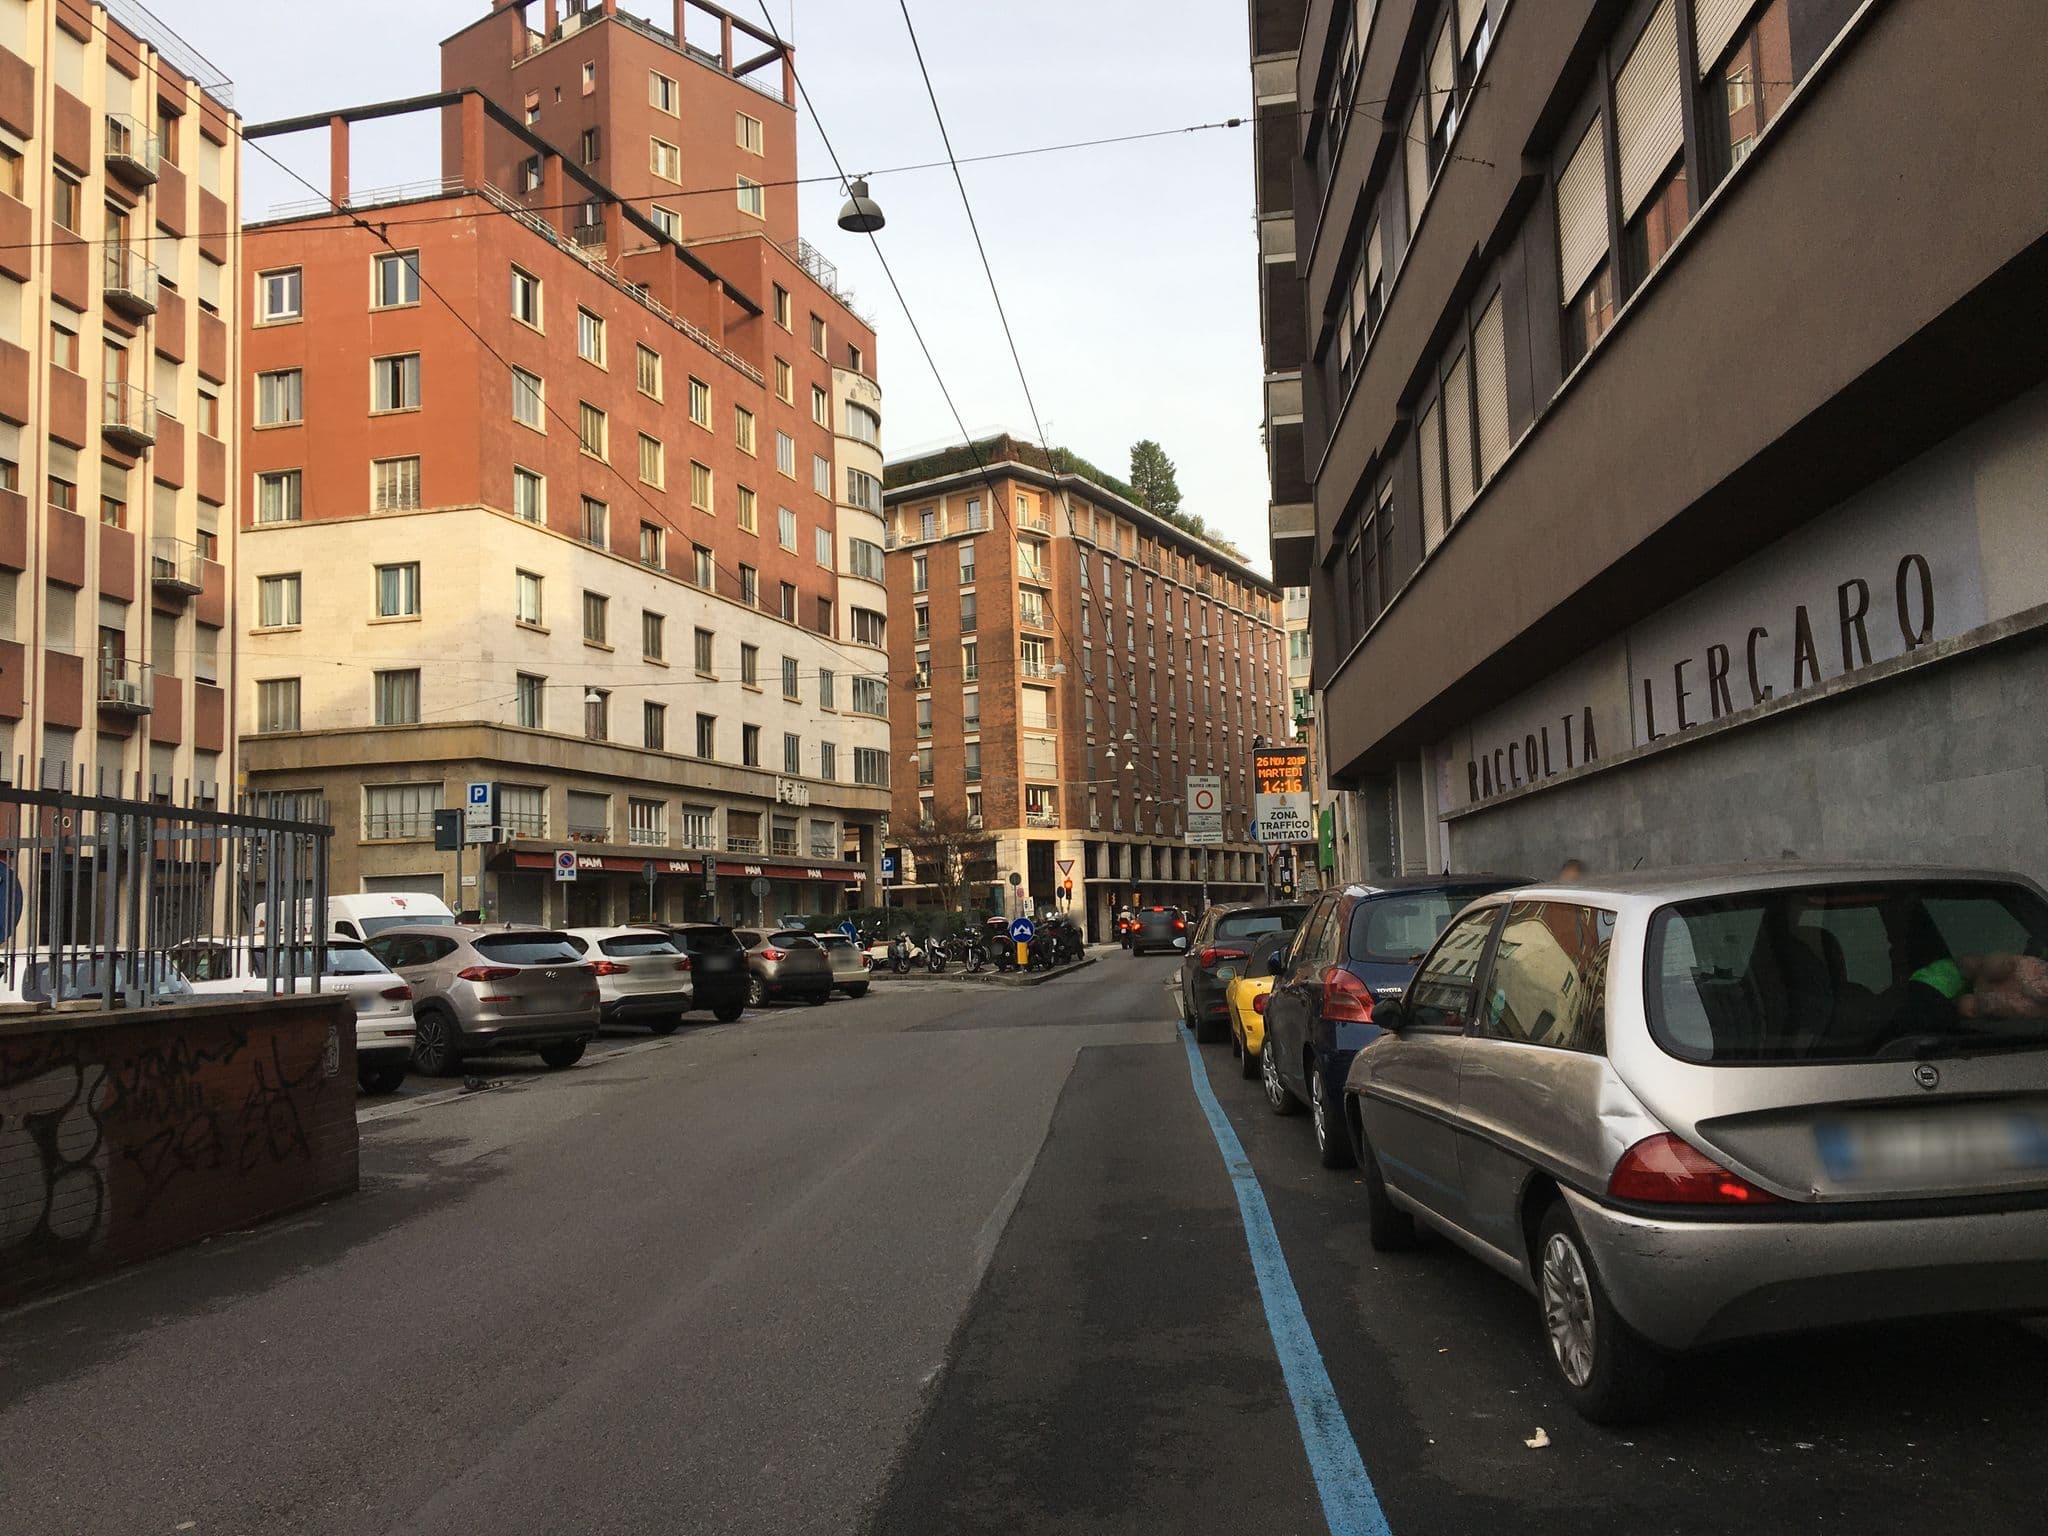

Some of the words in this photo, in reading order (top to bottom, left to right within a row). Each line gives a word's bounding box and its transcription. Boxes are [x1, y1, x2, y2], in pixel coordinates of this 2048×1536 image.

[1467, 706, 1599, 802] RACCOLTA
[1643, 553, 1935, 741] LERCARO
[1256, 757, 1269, 767] 26
[1258, 767, 1303, 778] MARTEDI
[1263, 779, 1303, 795] 14:16
[1270, 811, 1298, 820] ZONA
[1260, 820, 1310, 830] TRAFFICO
[1262, 830, 1308, 840] LIMITATO
[578, 857, 603, 868] PAM
[669, 861, 690, 872] PAM
[745, 865, 762, 875] PAM
[807, 869, 822, 879] PAM
[853, 871, 867, 880] PAM
